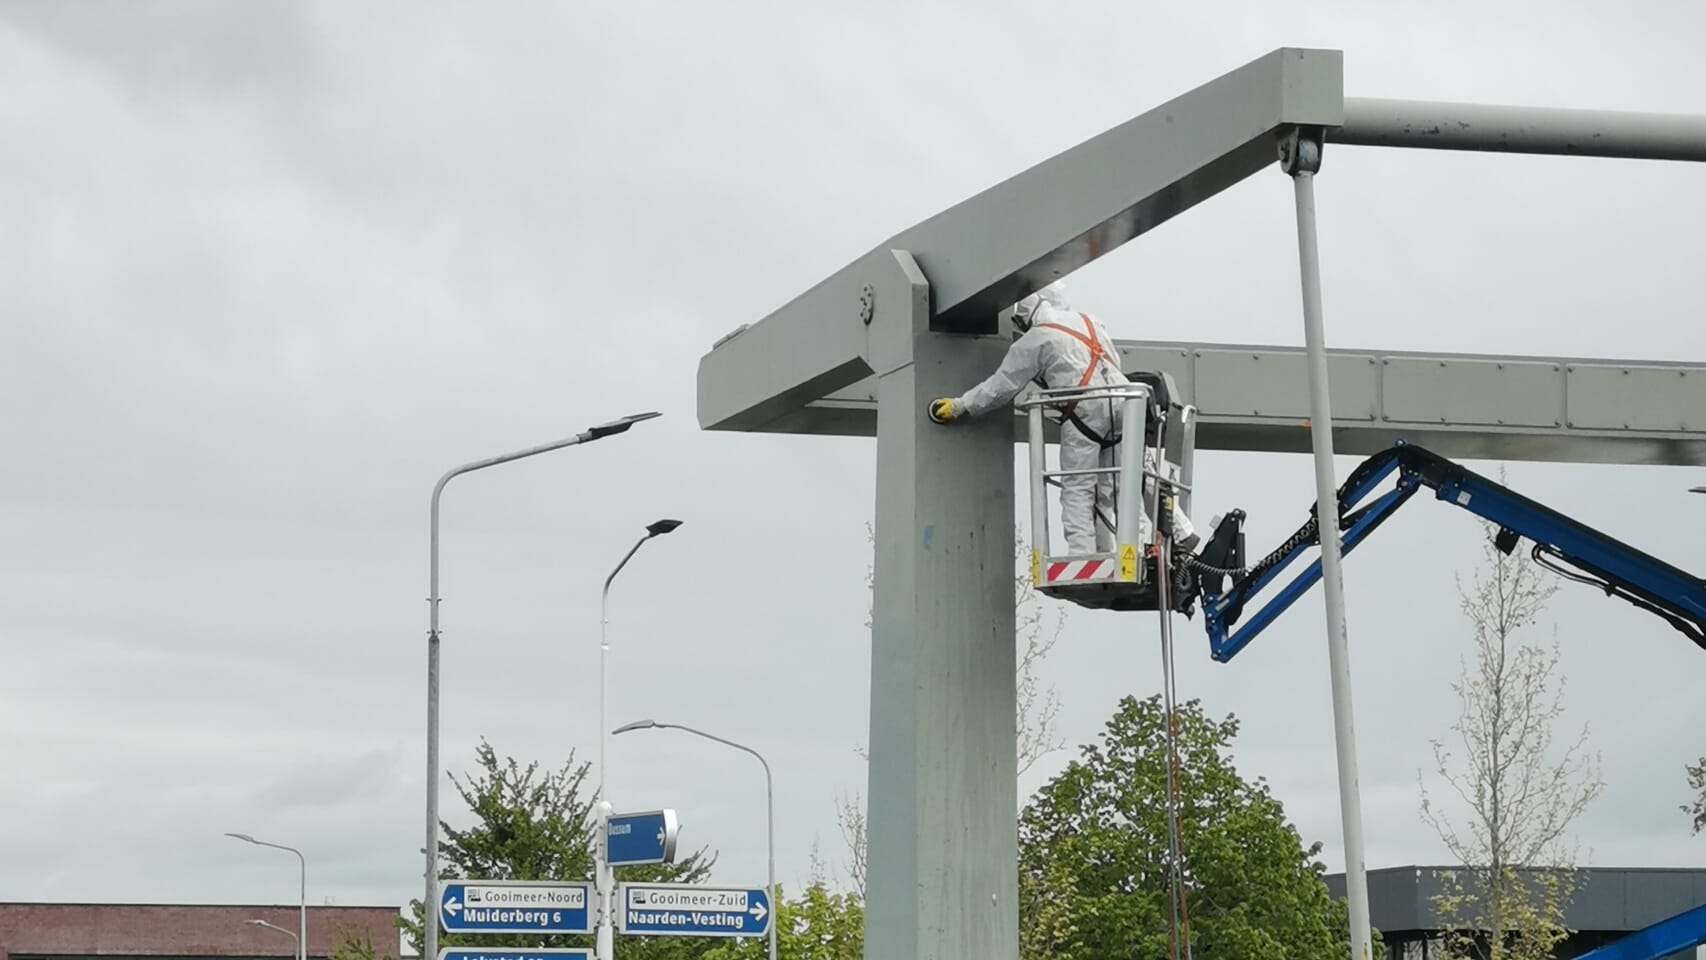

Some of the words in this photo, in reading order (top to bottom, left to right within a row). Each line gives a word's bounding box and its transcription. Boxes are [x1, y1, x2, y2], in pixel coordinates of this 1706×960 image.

[485, 890, 583, 903] Gooimeer-Noord
[649, 892, 746, 906] Gooimeer-Zuid
[463, 909, 548, 926] Muiderberg
[553, 912, 562, 923] 6
[628, 911, 744, 929] Naarden-Vesting
